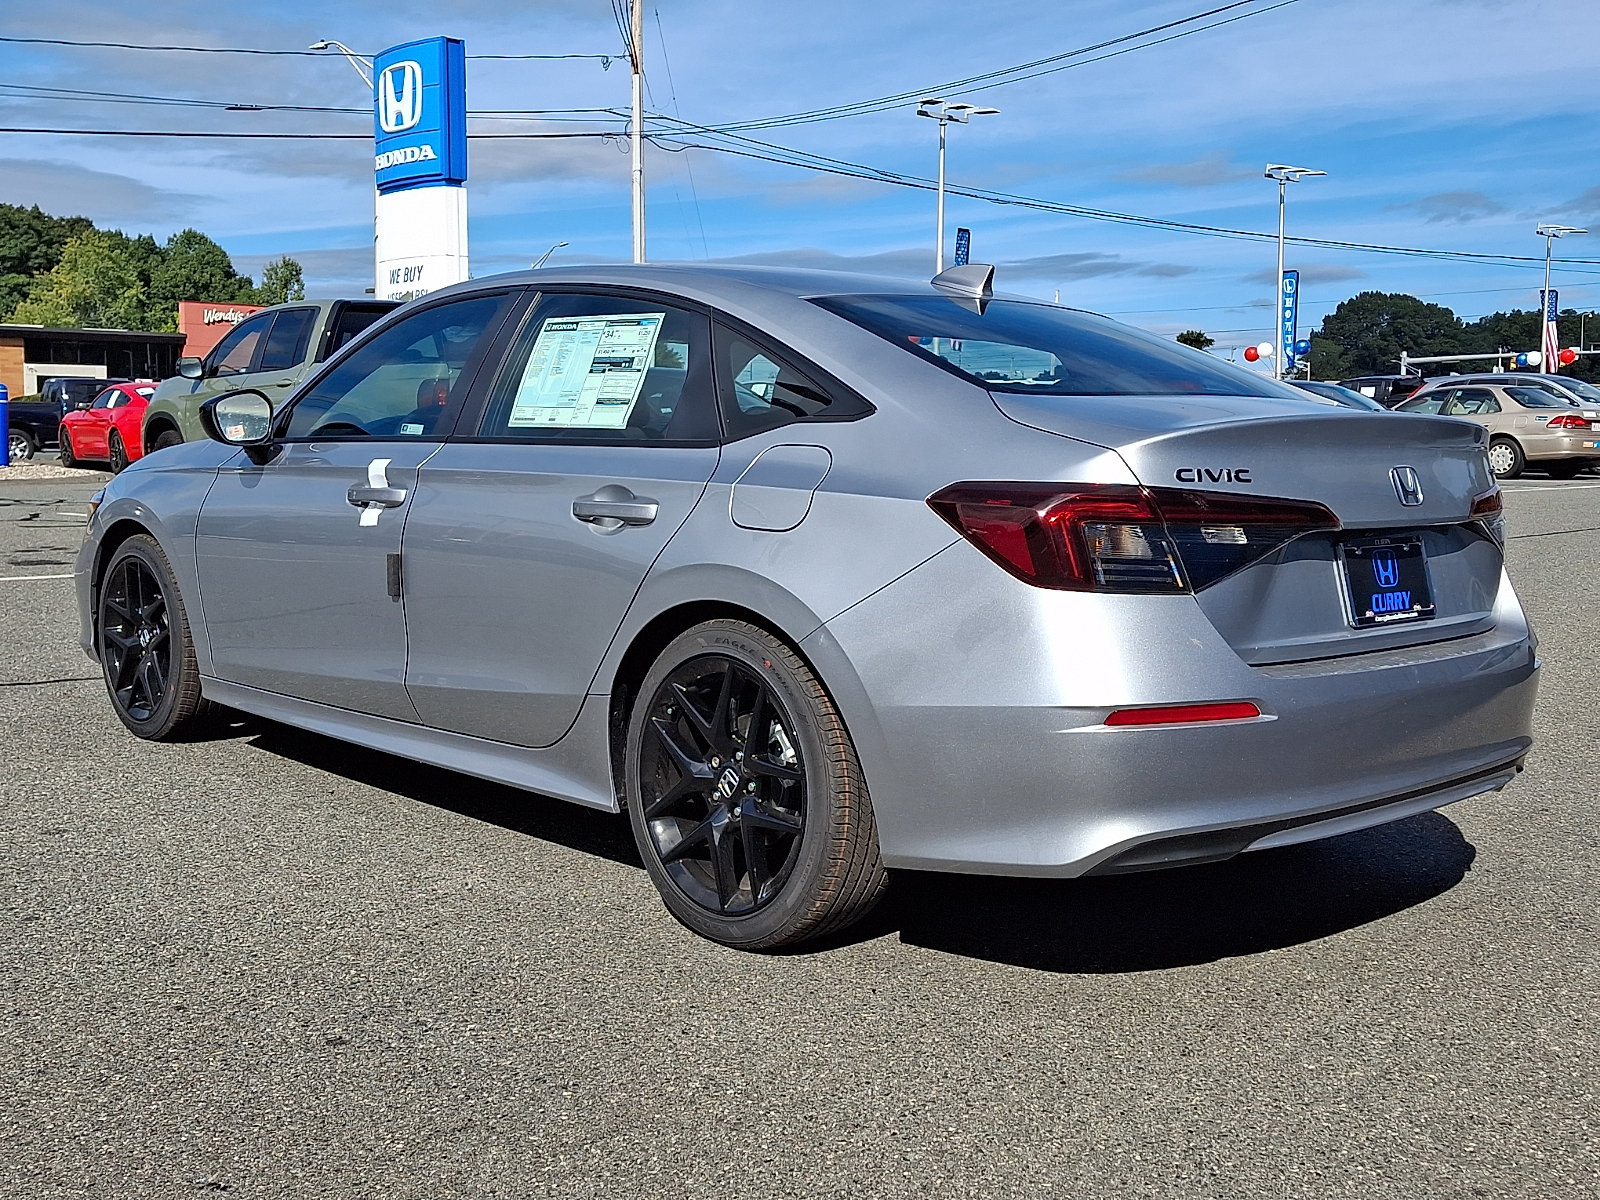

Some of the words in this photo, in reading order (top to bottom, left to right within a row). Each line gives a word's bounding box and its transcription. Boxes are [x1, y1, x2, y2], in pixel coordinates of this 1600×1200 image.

[375, 144, 438, 171] HONDA
[389, 269, 401, 285] WE
[403, 265, 424, 283] BUY
[551, 323, 578, 331] HONDA
[1175, 467, 1253, 484] CIVIC
[1371, 591, 1411, 612] CURRY
